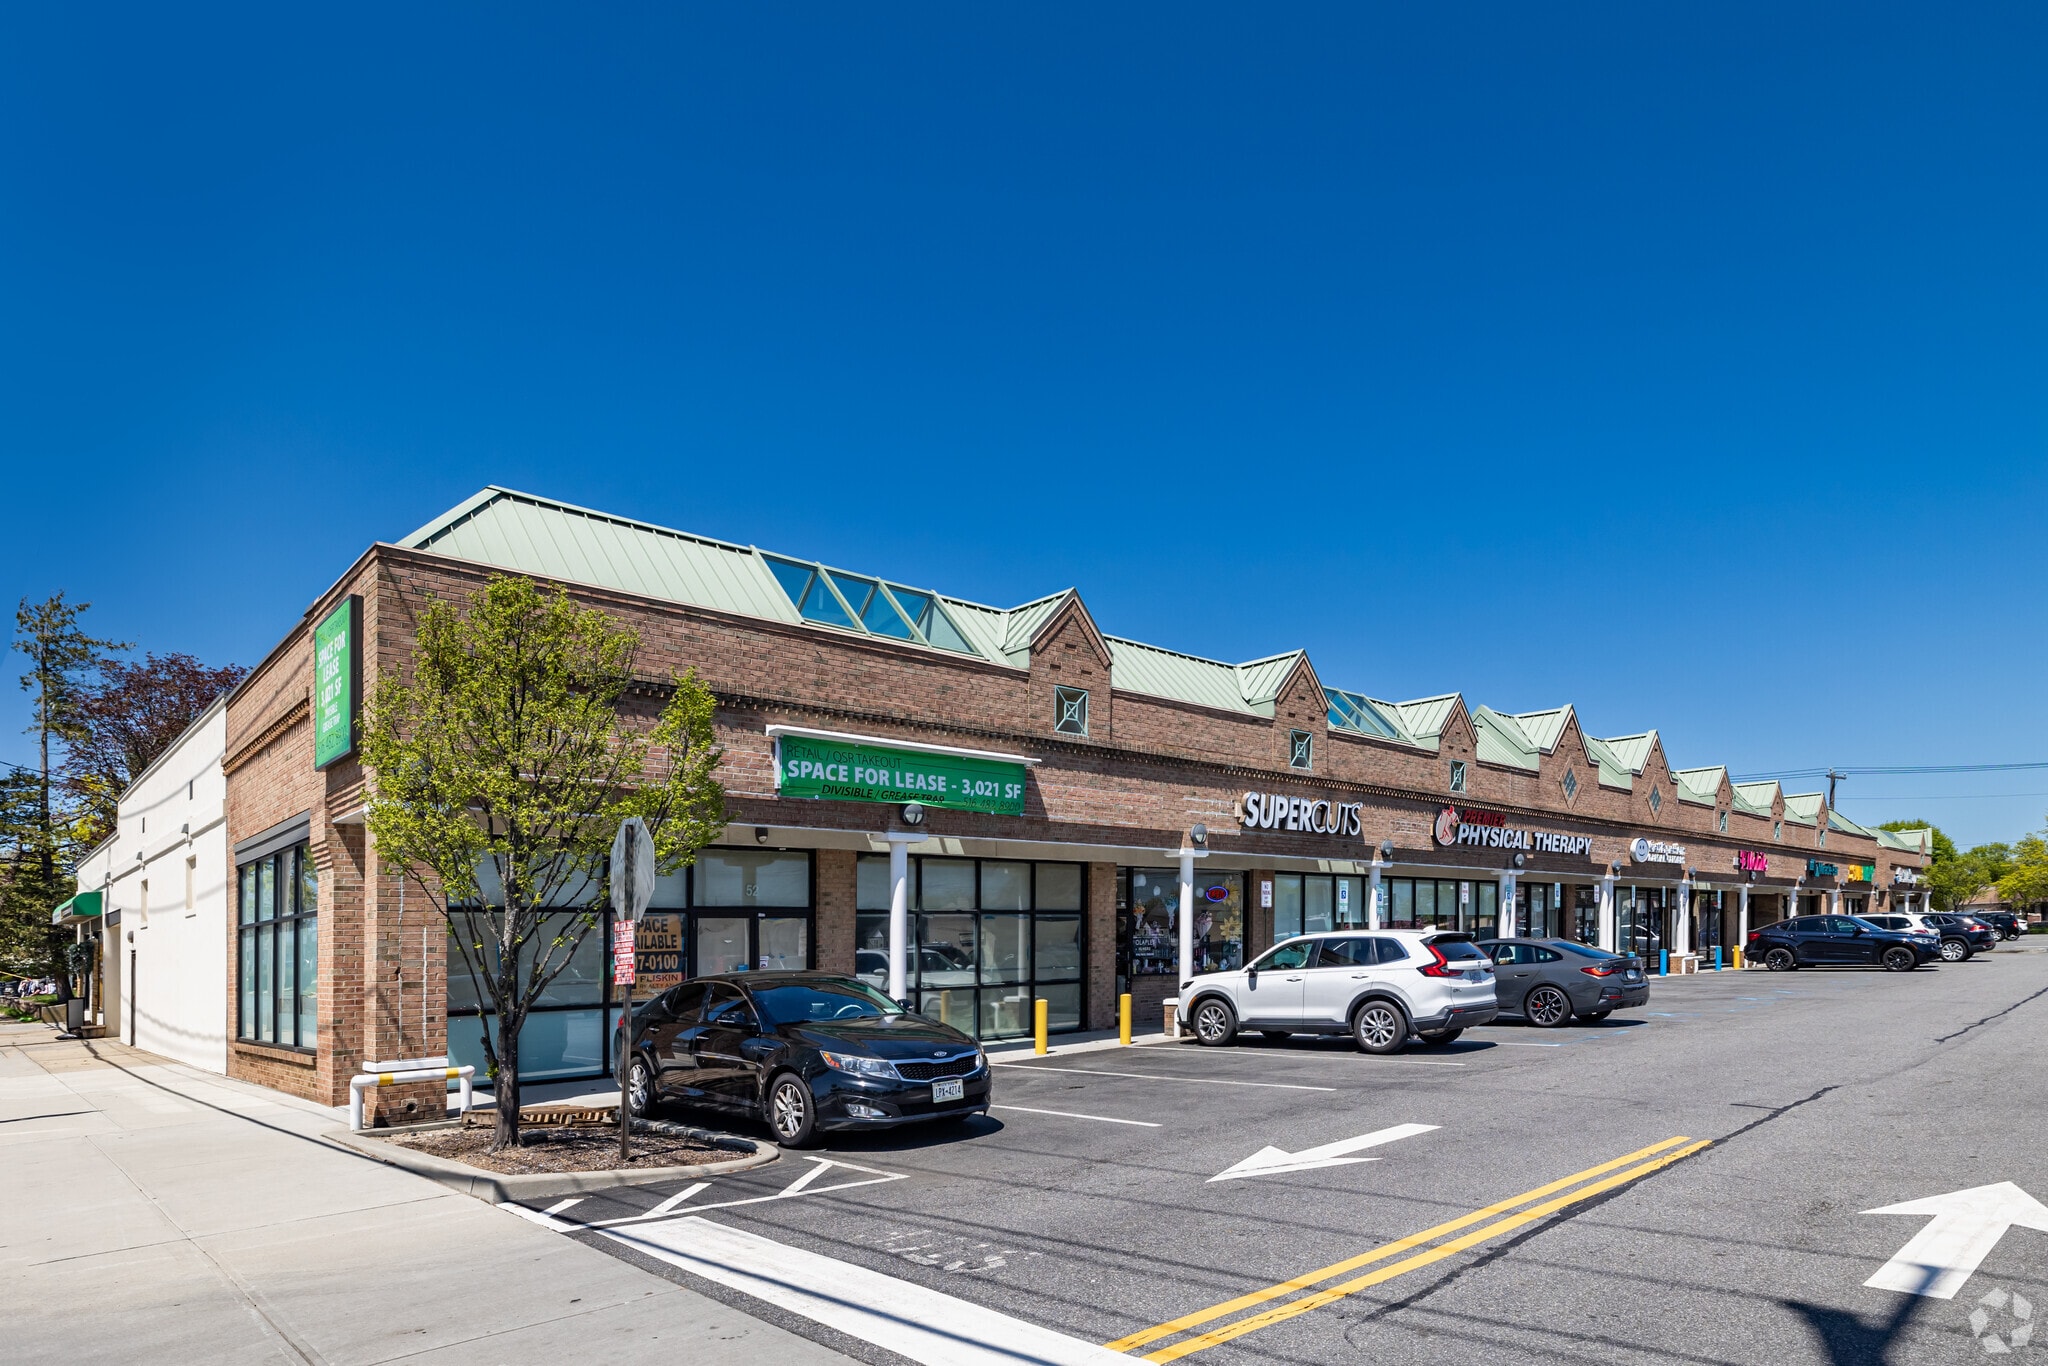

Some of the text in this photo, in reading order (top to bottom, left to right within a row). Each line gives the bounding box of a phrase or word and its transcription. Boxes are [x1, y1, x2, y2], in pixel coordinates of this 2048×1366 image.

[334, 630, 346, 655] FOR
[323, 656, 339, 683] LEASE
[786, 744, 824, 761] RETAIL
[833, 751, 855, 764] QSR
[856, 754, 902, 769] TAKEOUT
[787, 760, 849, 783] SPACE
[854, 767, 890, 786] FOR
[895, 771, 947, 792] LEASE
[961, 779, 1000, 797] 3,021
[1005, 783, 1021, 799] SF
[821, 784, 874, 799] DIVISIBLE
[1243, 791, 1364, 836] SUPERCUTS
[1463, 809, 1507, 828] PREMIER
[1457, 824, 1593, 855] PHYSICAL THERAPY
[746, 884, 759, 897] 52
[635, 918, 669, 933] PACE
[635, 934, 678, 950] AILABLE
